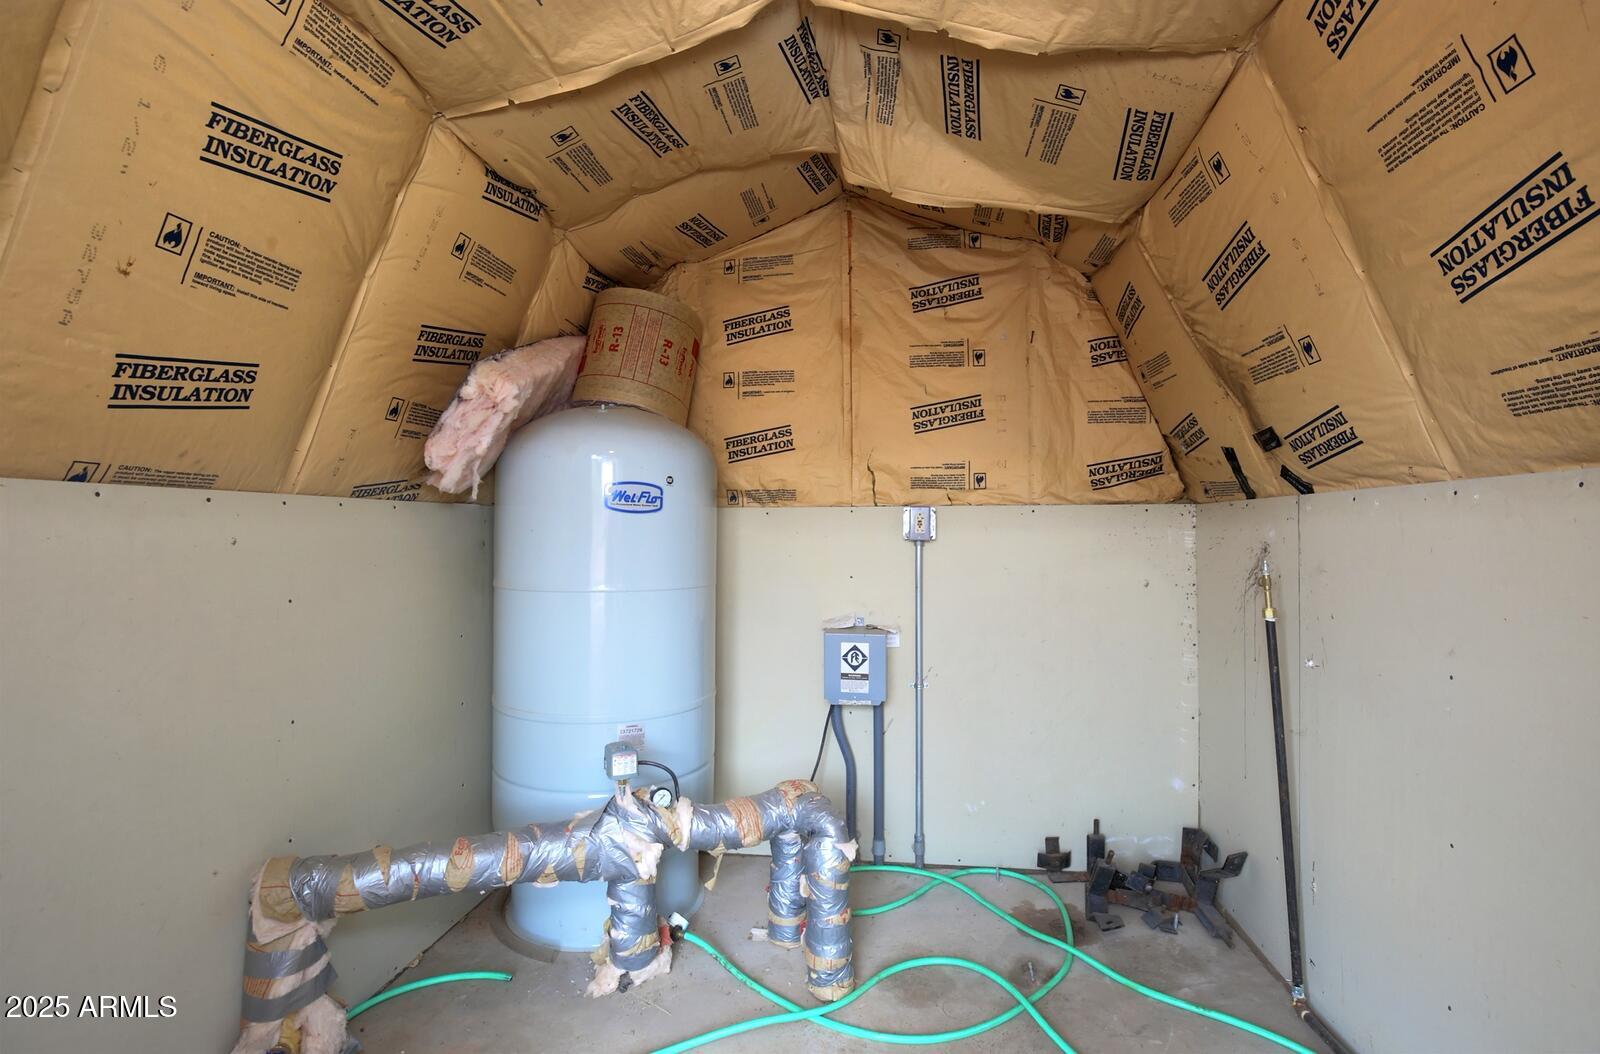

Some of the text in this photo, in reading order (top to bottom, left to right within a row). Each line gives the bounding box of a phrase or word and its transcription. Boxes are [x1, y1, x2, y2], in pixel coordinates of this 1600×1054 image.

[392, 0, 461, 42] ATION
[294, 38, 333, 70] IMPORTANT:
[784, 34, 821, 100] INSULATION
[1417, 54, 1461, 92] IMPORTANT:
[946, 55, 962, 138] INSULATION
[961, 58, 976, 139] FIBERGLASS
[616, 103, 673, 154] INSULATION
[628, 94, 684, 149] FIBERGLASS
[1450, 103, 1485, 130] CAUTION:
[205, 111, 341, 176] FIBERGLASS
[1120, 108, 1148, 181] INSULATION
[1136, 110, 1167, 181] FIBERGLASS
[202, 135, 338, 194] INSULATION
[1438, 161, 1576, 277] INSULATION
[209, 231, 241, 249] CAUTION:
[1450, 184, 1596, 296] FIBERGLASS
[1206, 226, 1256, 293] INSULATION
[1215, 240, 1266, 306] FIBERGLASS
[194, 272, 235, 291] IMPORTANT:
[910, 274, 980, 300] INSULATION
[912, 287, 982, 310] FIBERGLASS
[724, 306, 790, 332] FIBERGLASS
[726, 319, 792, 342] INSULATION
[417, 330, 484, 349] FIBERGLASS
[608, 326, 624, 352] R-13
[660, 339, 673, 367] R-13
[414, 345, 482, 362] INSULATION
[1091, 348, 1127, 363] GLASS
[112, 362, 258, 384] FIBERGLASS
[110, 384, 254, 402] INSULATION
[912, 398, 982, 420] INSULATION
[913, 409, 984, 430] FIBERGLASS
[725, 428, 792, 450] FIBERGLASS
[1288, 411, 1348, 453] INSULATION
[1298, 426, 1358, 465] FIBERGLASS
[728, 438, 794, 460] INSULATION
[1088, 452, 1163, 477] INSULATION
